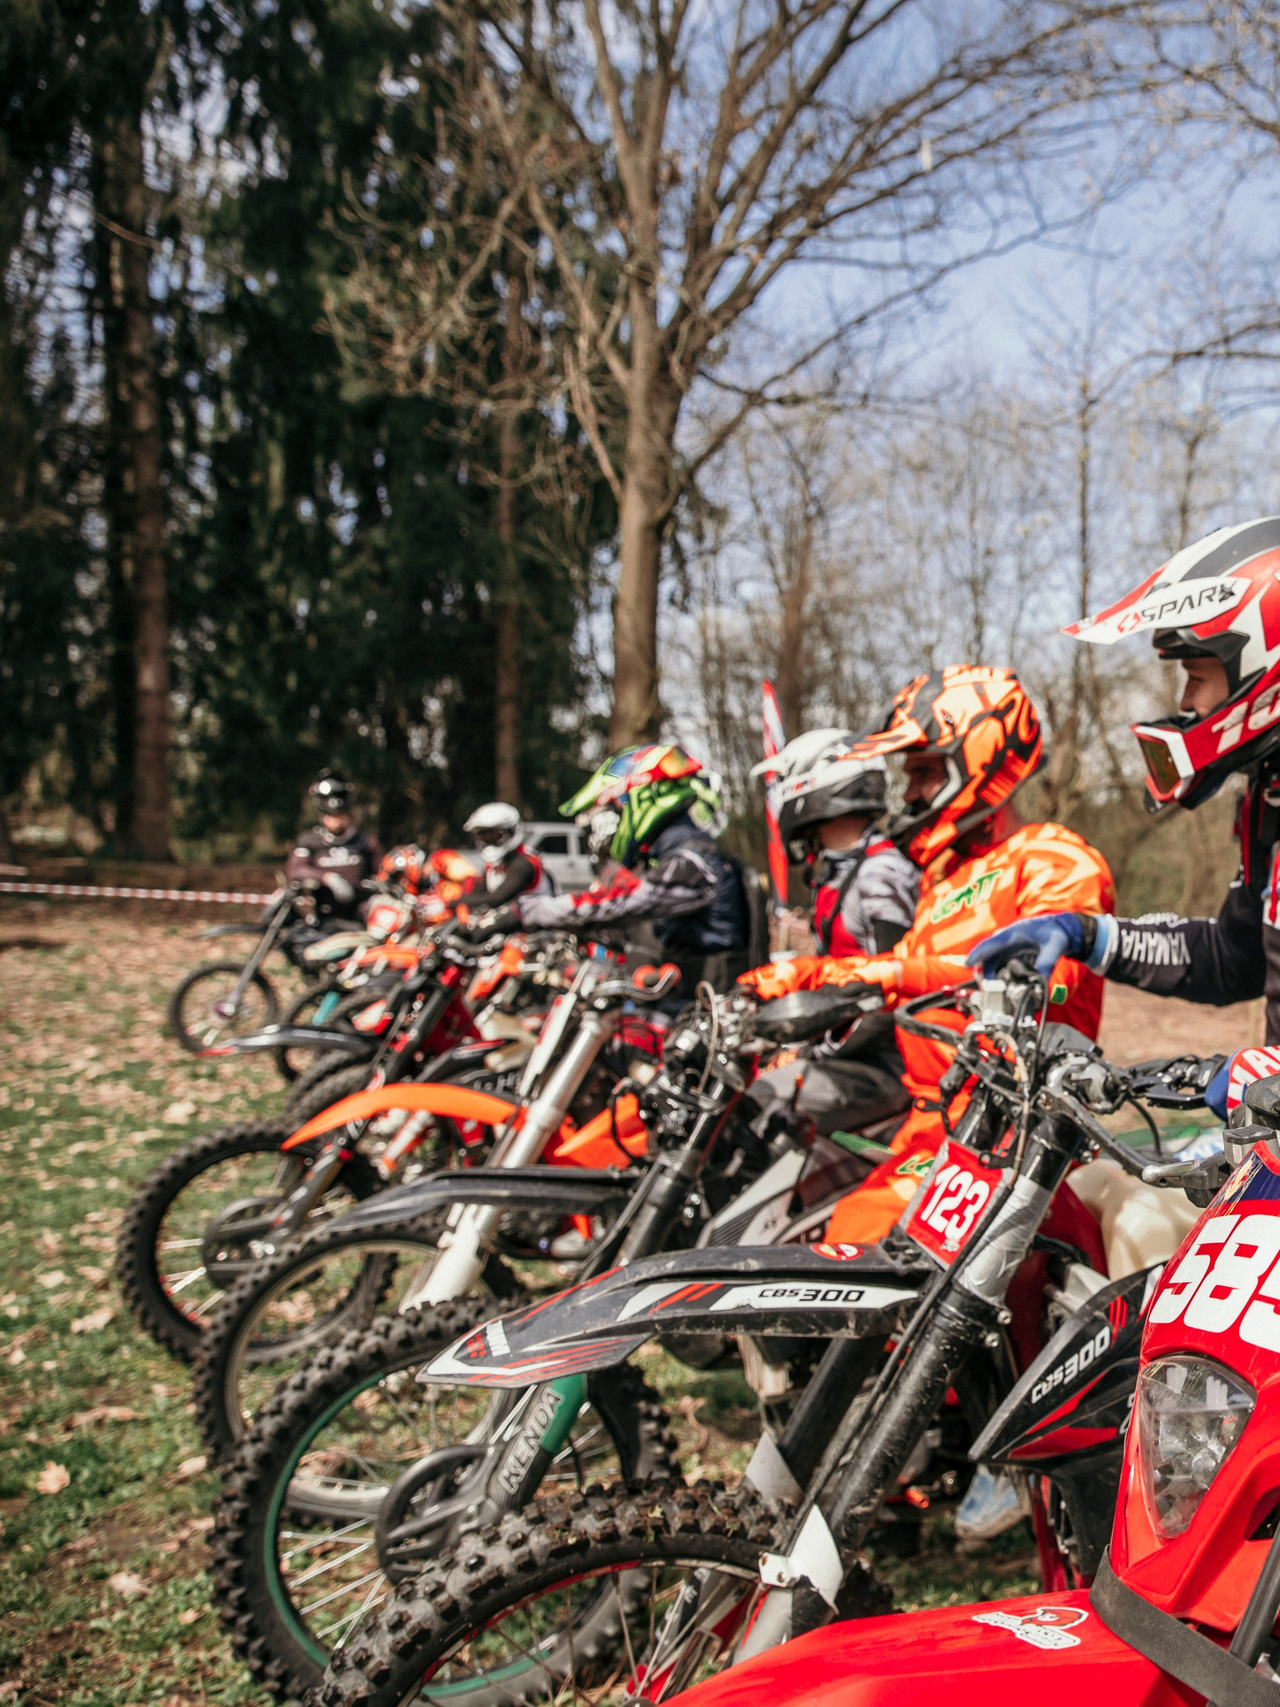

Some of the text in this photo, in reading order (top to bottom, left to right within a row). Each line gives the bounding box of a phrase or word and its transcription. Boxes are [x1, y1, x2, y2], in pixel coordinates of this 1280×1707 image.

[1121, 928, 1191, 966] YAMAHA
[920, 1164, 990, 1242] 123
[498, 1386, 566, 1495] KENDA
